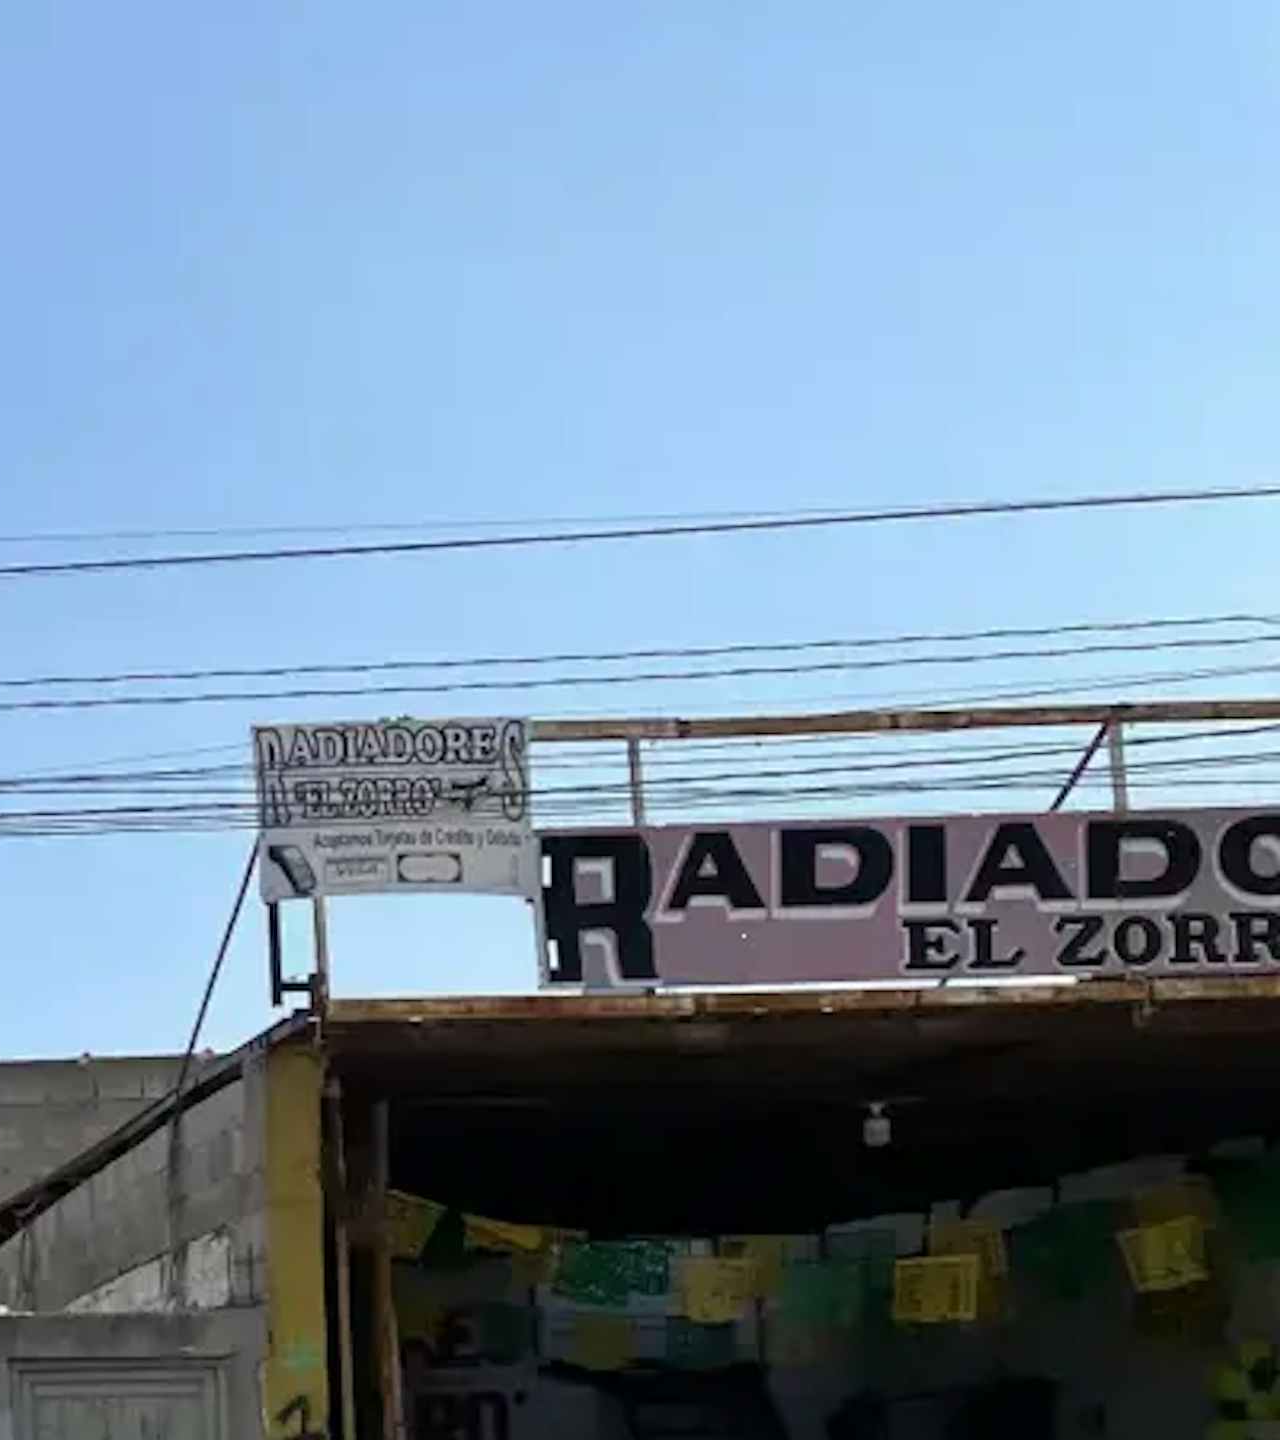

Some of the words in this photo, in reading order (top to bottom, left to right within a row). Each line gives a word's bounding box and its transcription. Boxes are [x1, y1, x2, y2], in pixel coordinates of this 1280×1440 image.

[541, 814, 1280, 981] RADIADO
[902, 917, 1025, 971] EL
[1054, 911, 1280, 967] ZORR
